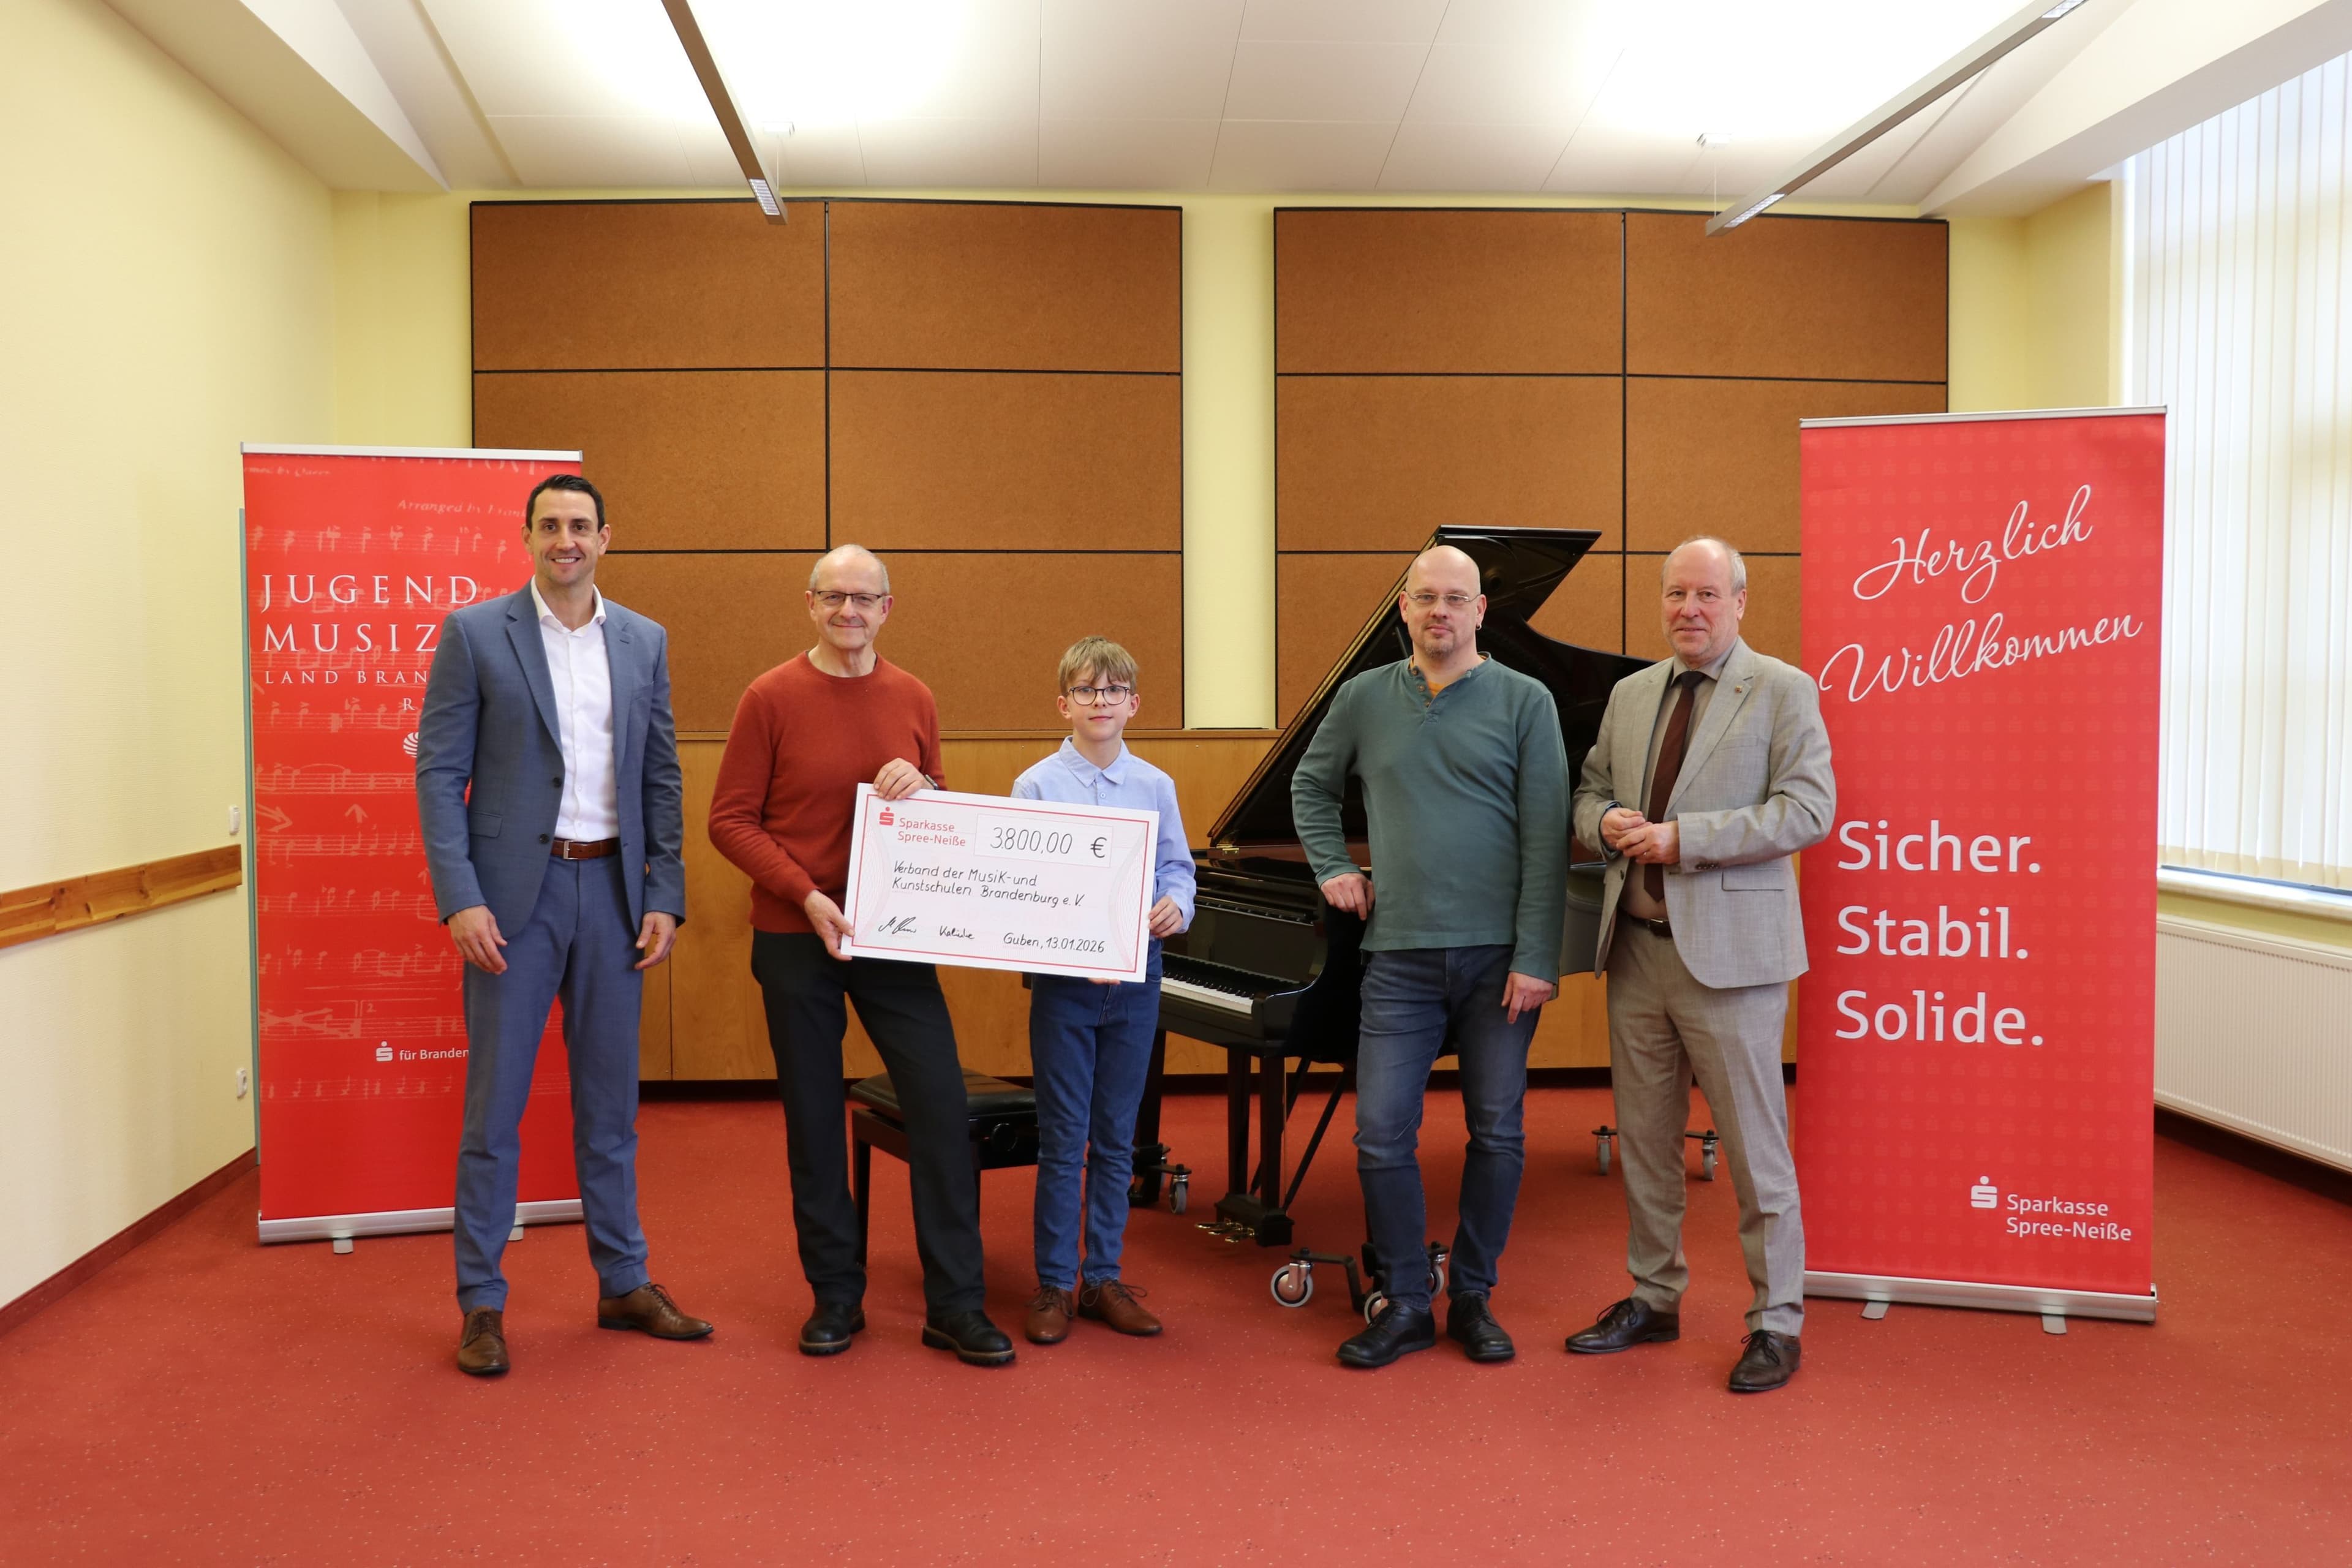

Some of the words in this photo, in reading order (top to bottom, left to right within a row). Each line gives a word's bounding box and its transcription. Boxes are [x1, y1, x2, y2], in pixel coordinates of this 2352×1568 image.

[1853, 484, 2093, 604] Herzlich
[262, 575, 477, 612] JUGEND
[1819, 612, 2143, 702] Willkommen
[266, 671, 338, 684] LAND
[899, 818, 955, 832] Sparkasse
[897, 831, 966, 846] Spree-Neiße
[1090, 837, 1107, 858] €
[1839, 820, 2040, 872] Sicher.
[894, 861, 939, 876] Verband
[943, 867, 963, 879] der
[892, 877, 971, 895] Kunstschulen
[981, 885, 1058, 908] Brandenburg
[1003, 933, 1042, 949] Guben,
[1046, 937, 1104, 952] 13.01.2026
[1838, 906, 2027, 959] Stabil.
[1836, 990, 2042, 1045] Solide.
[399, 1049, 417, 1060] für
[2007, 1194, 2108, 1217] Sparkasse
[2007, 1216, 2132, 1241] Spree-Neiße
